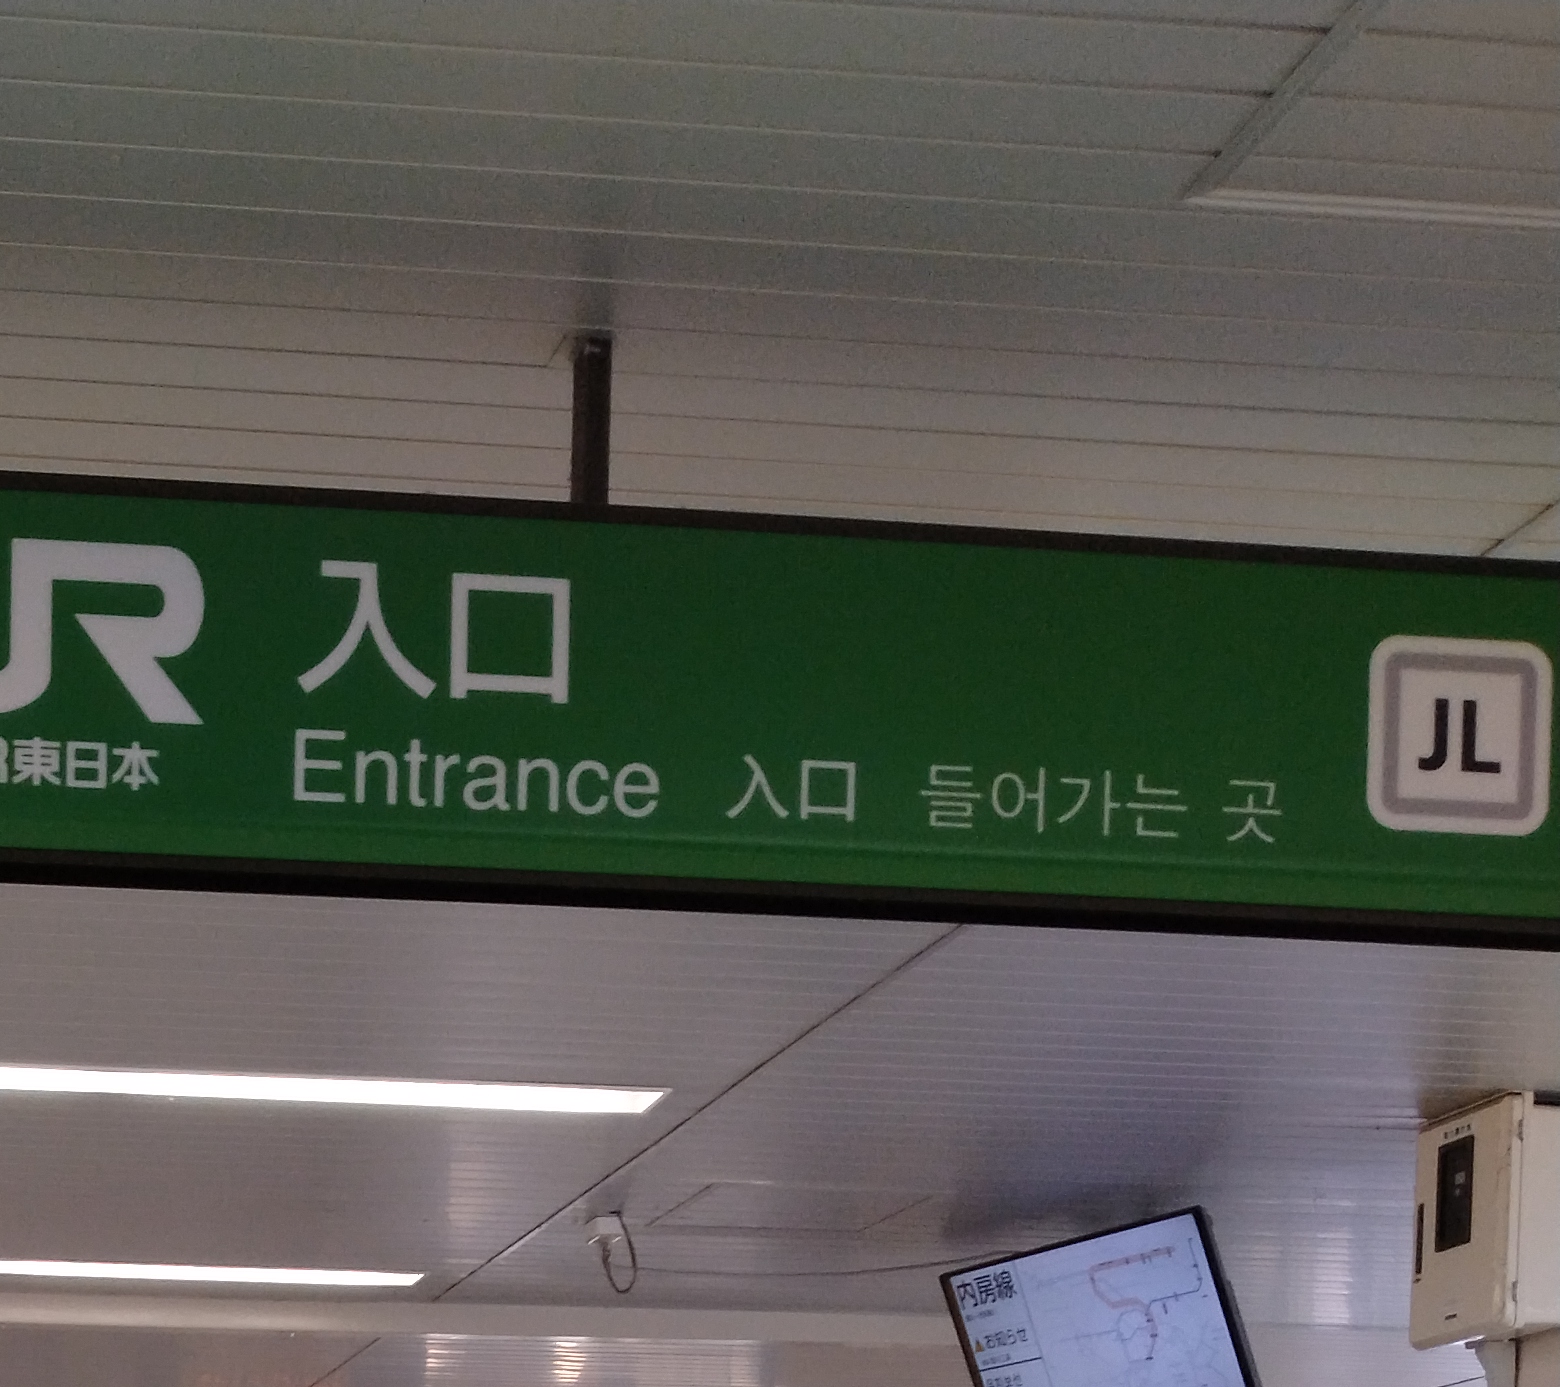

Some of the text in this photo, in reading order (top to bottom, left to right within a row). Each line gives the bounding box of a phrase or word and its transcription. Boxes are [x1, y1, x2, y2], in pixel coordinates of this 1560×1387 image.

[297, 560, 570, 704] 入口
[293, 728, 661, 818] Entrance
[1419, 698, 1501, 775] JL
[725, 754, 857, 821] 入口
[919, 764, 1283, 844] 들어가는 곳
[956, 1269, 1017, 1310] 内房線
